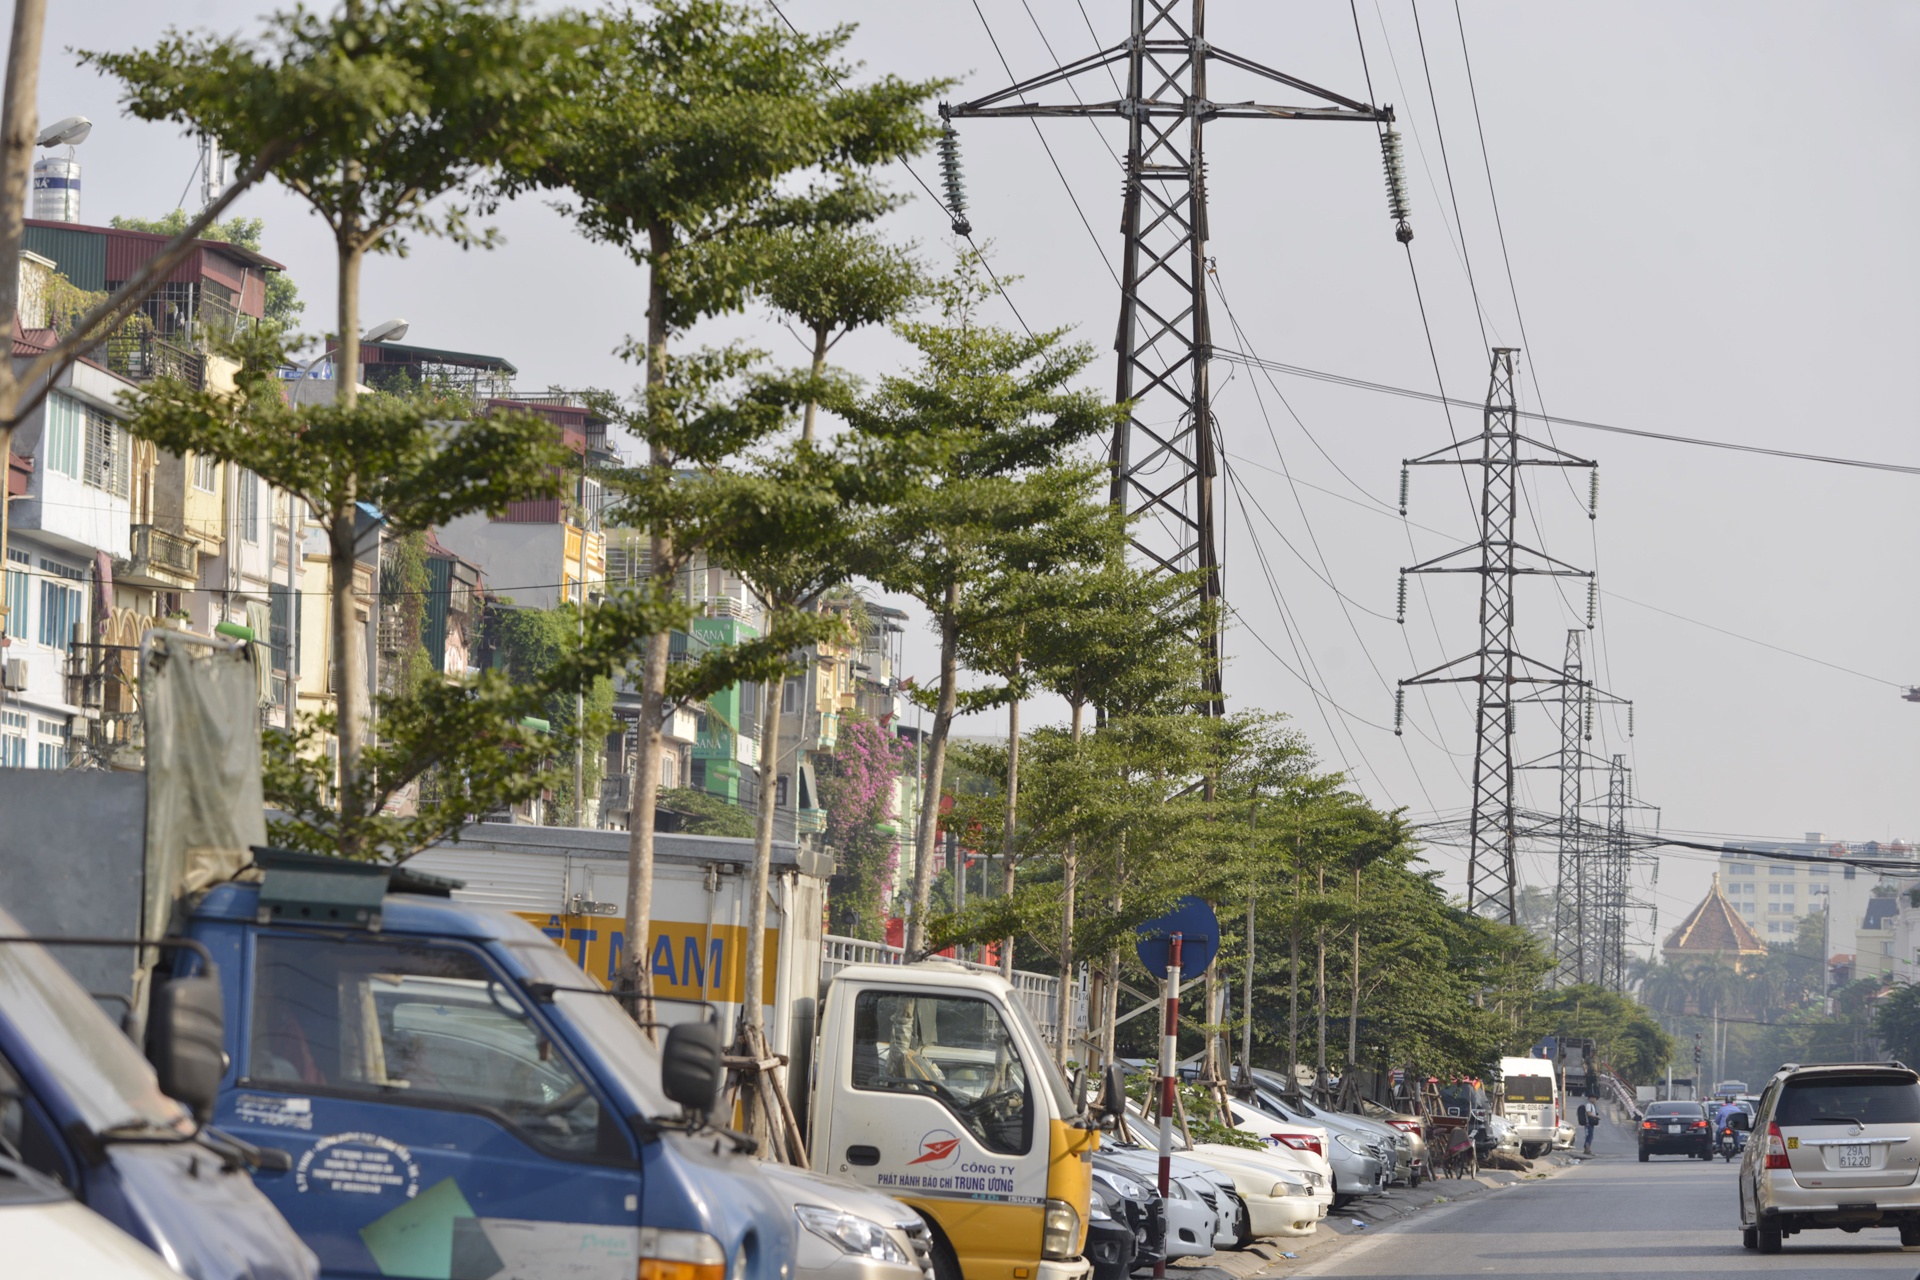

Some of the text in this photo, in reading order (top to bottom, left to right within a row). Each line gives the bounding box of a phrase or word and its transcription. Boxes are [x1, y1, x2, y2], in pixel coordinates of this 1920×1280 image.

[1846, 1146, 1863, 1156] 29A
[961, 1162, 1015, 1175] CÔNG TY
[878, 1172, 1014, 1192] PHÁT HÀNH BÁO CHÍ TRUNG ƯƠNG
[1008, 1195, 1038, 1204] ISUZU
